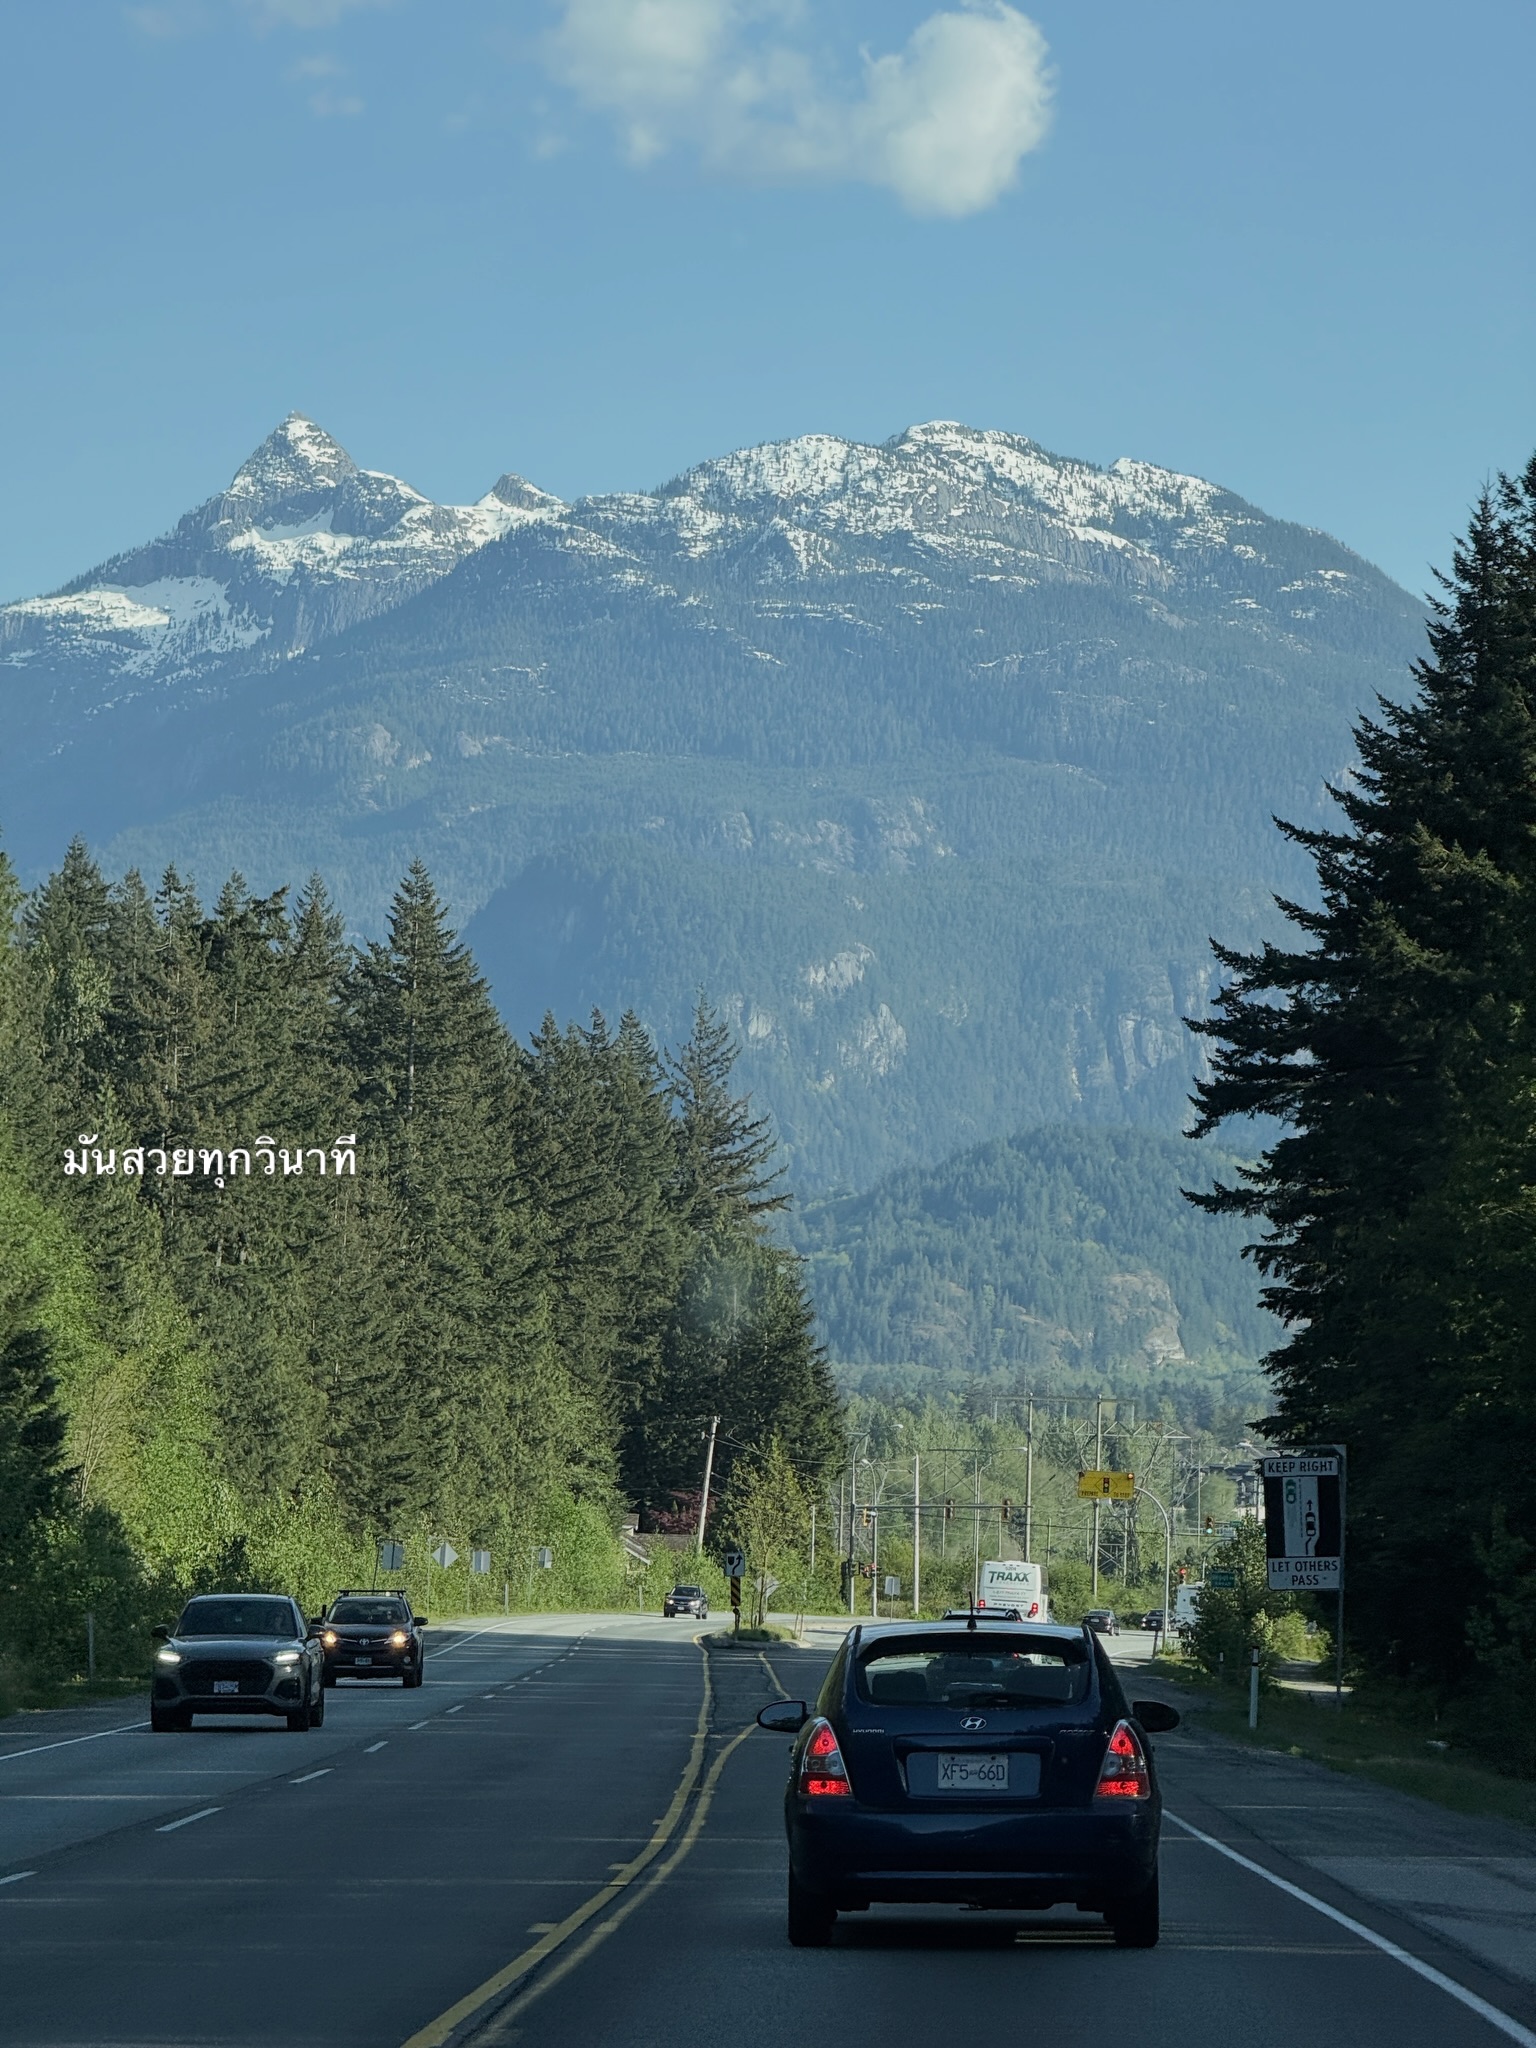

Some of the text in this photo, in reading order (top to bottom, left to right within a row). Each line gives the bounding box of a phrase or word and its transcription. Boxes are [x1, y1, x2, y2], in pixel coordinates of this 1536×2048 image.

[1268, 1460, 1334, 1473] KEEP RIGHT
[1272, 1560, 1338, 1573] LET OTHERS
[988, 1570, 1031, 1583] TRAXX
[1291, 1574, 1319, 1585] PASS
